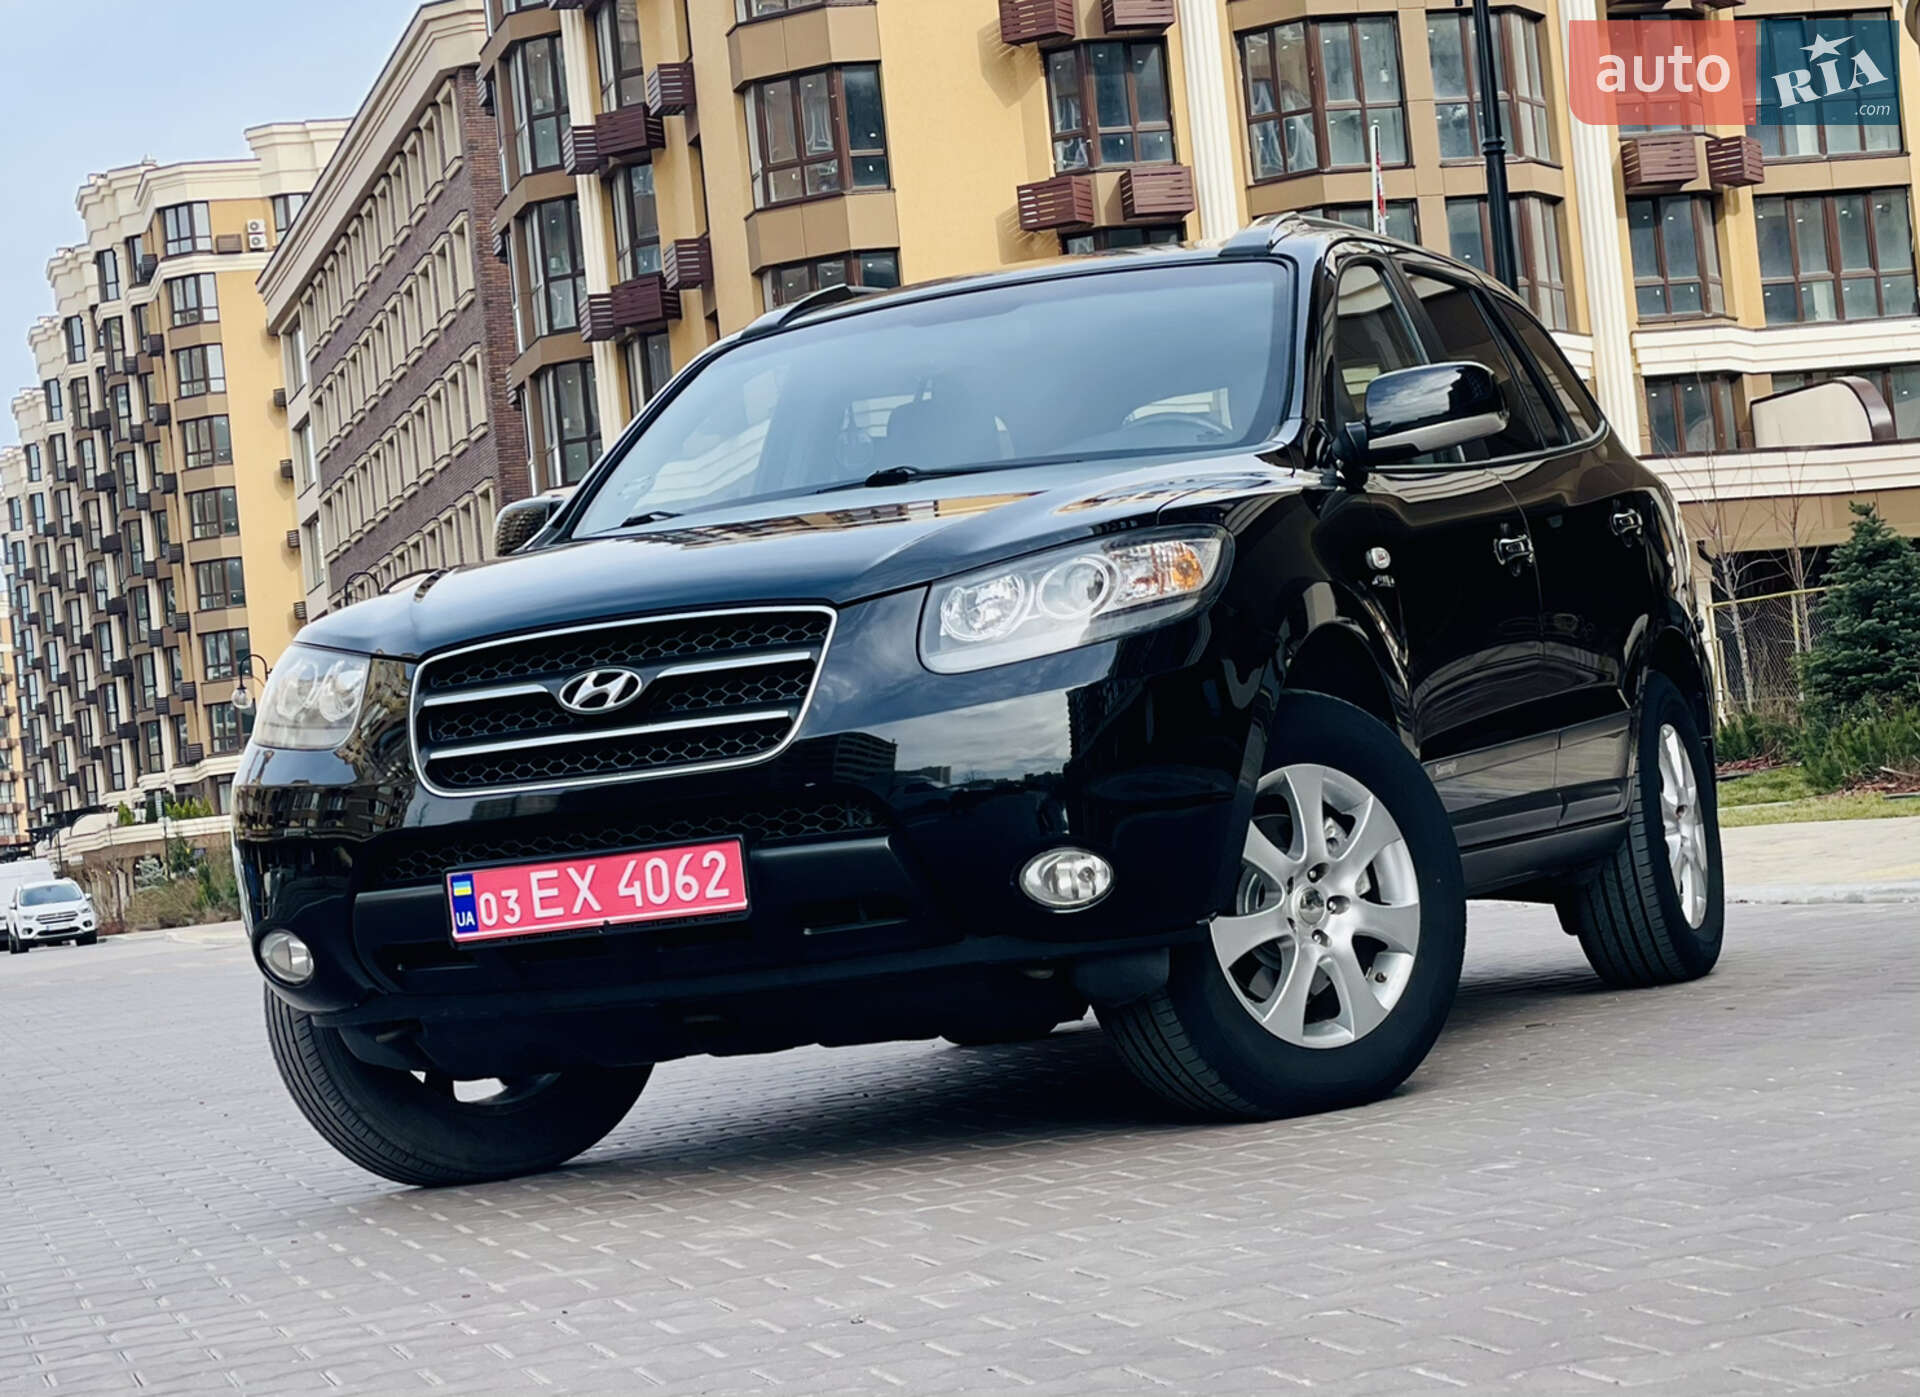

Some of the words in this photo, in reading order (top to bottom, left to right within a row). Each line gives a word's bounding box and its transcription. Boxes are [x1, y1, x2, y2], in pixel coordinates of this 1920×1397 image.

[479, 889, 521, 927] 03
[529, 864, 602, 919] EX
[617, 850, 730, 907] 4062
[456, 912, 476, 927] UA
